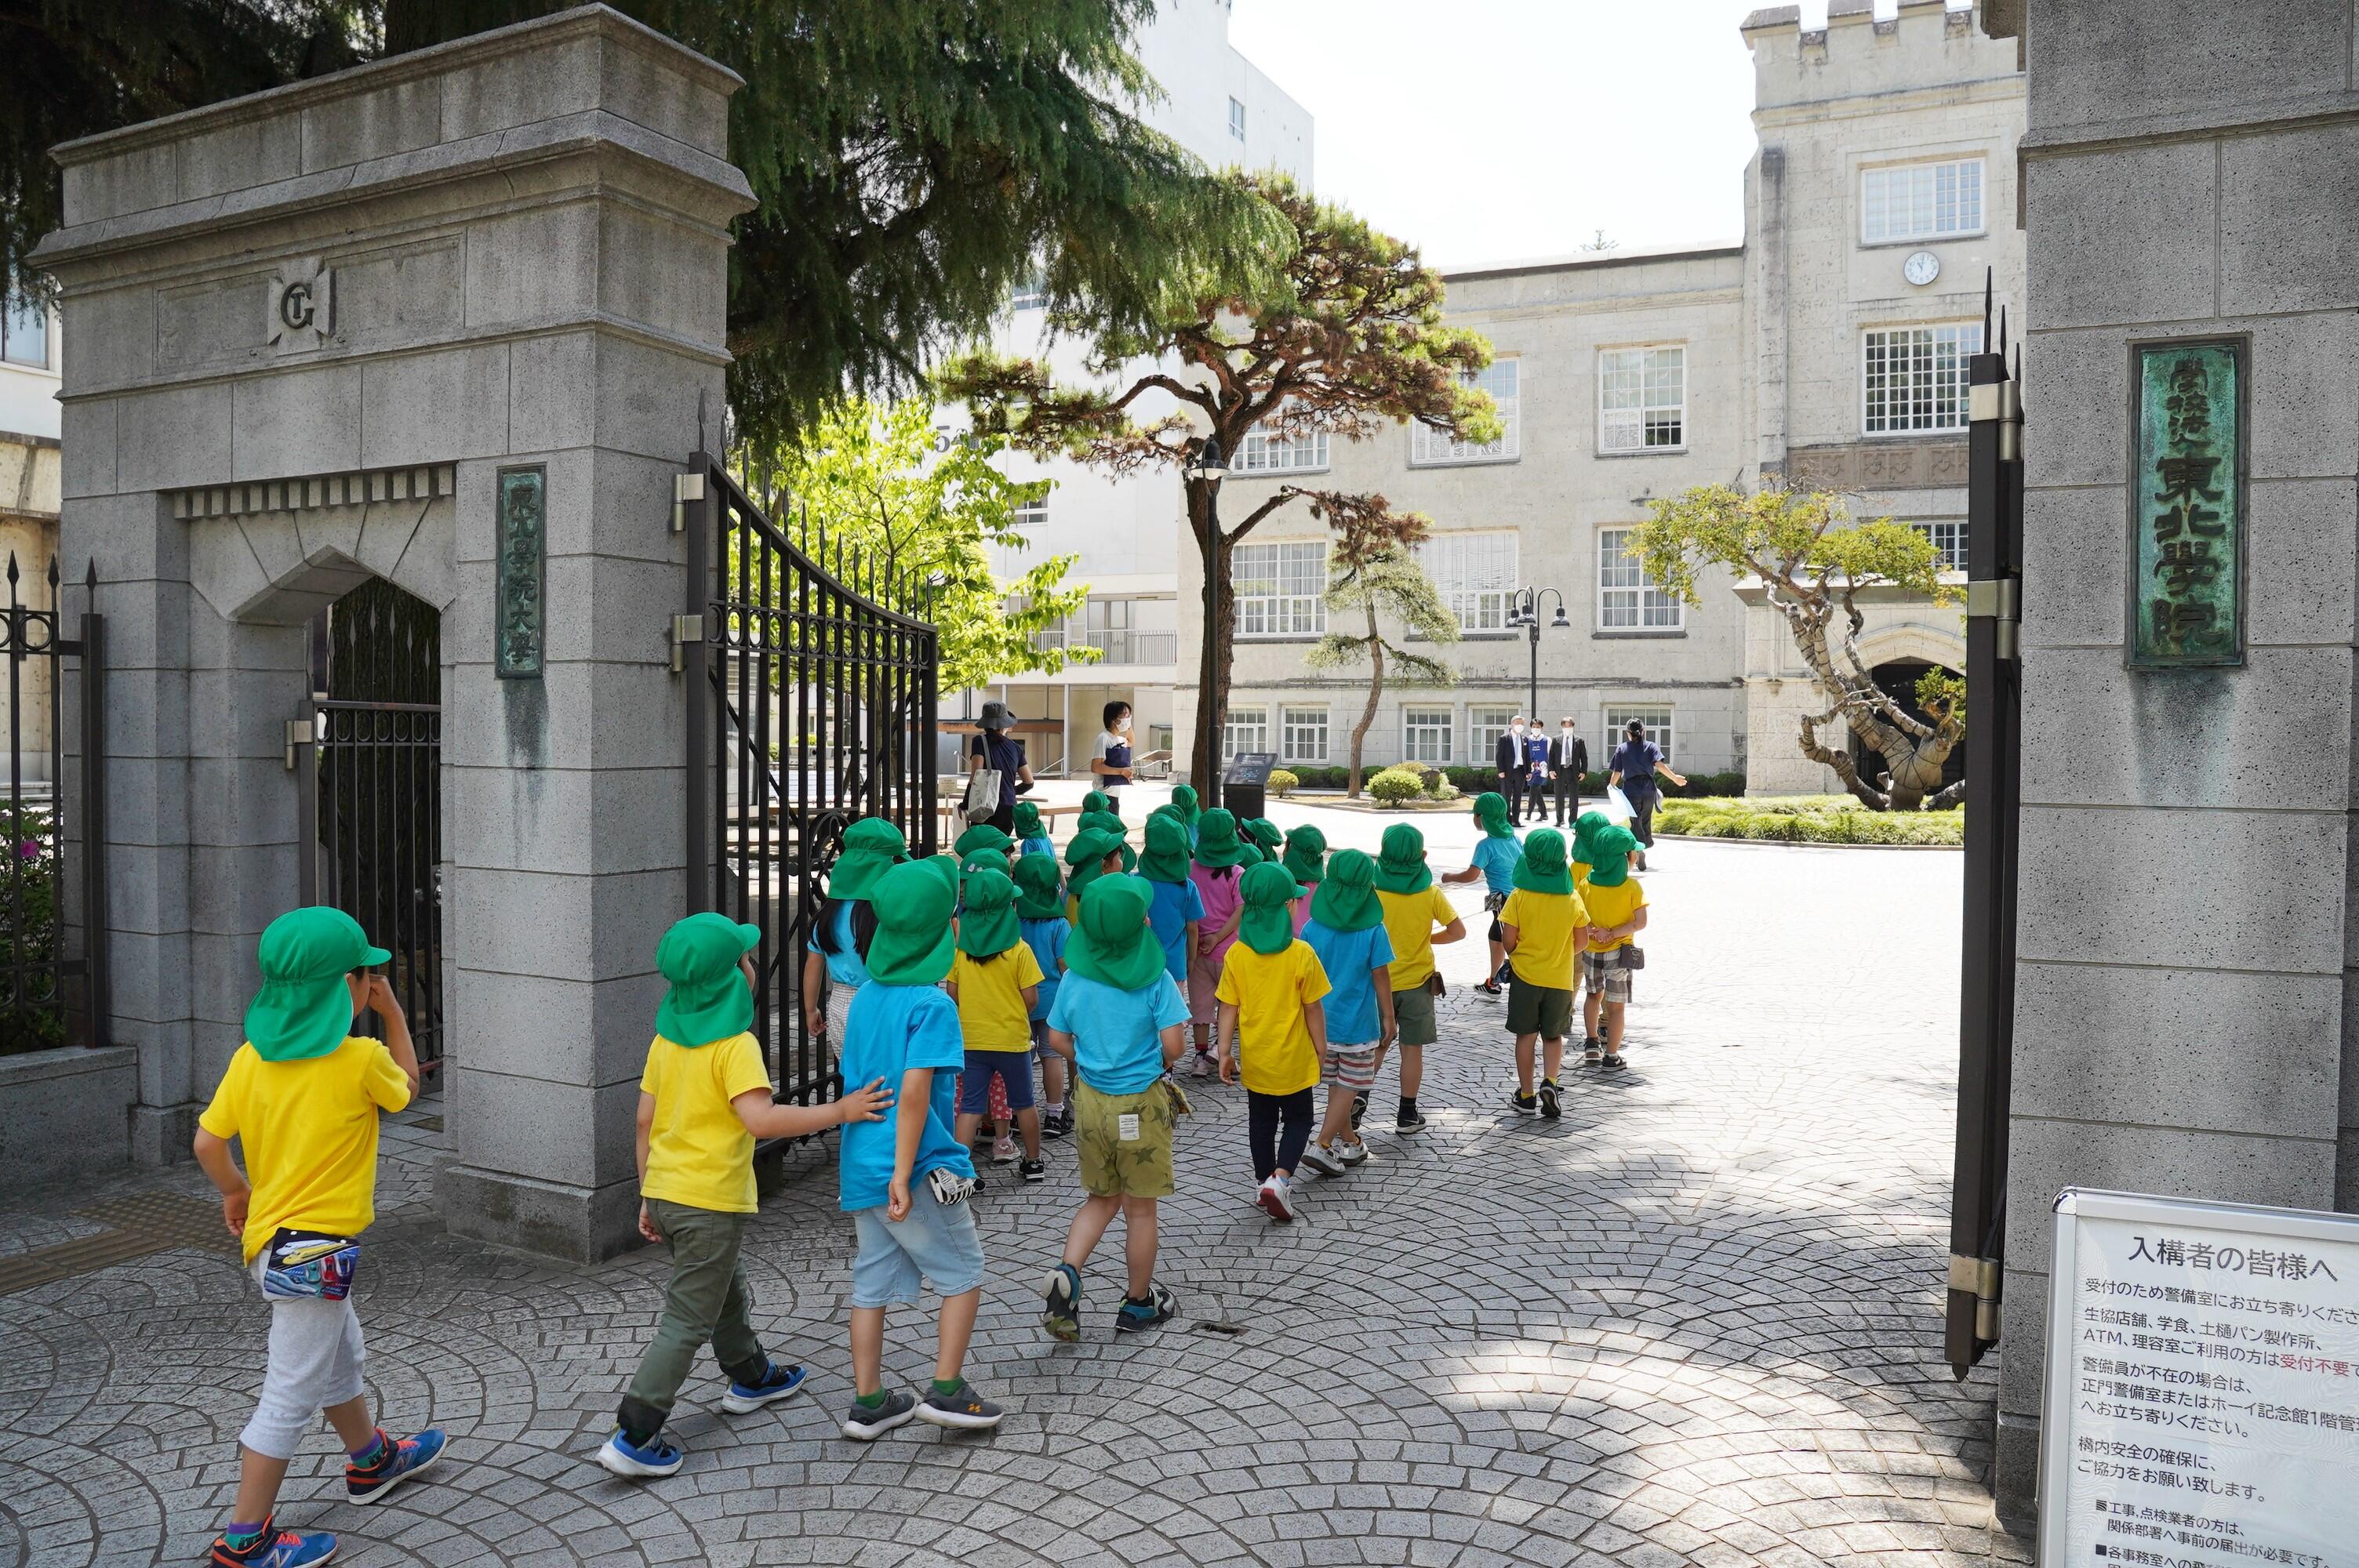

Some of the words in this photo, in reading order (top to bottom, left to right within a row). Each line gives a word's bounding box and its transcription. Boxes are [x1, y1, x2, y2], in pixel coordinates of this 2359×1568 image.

[2128, 1236, 2339, 1283] 入構者の皆様へ
[2082, 1356, 2252, 1393] 警備員が不在の場合は、
[2081, 1377, 2359, 1432] 正門警備室またはホーイ記念館1階管
[2081, 1400, 2248, 1438] へお立ち寄りください。
[2077, 1436, 2216, 1472] 構内安全の確保に、
[2077, 1459, 2265, 1502] ご協力をお願い致します。
